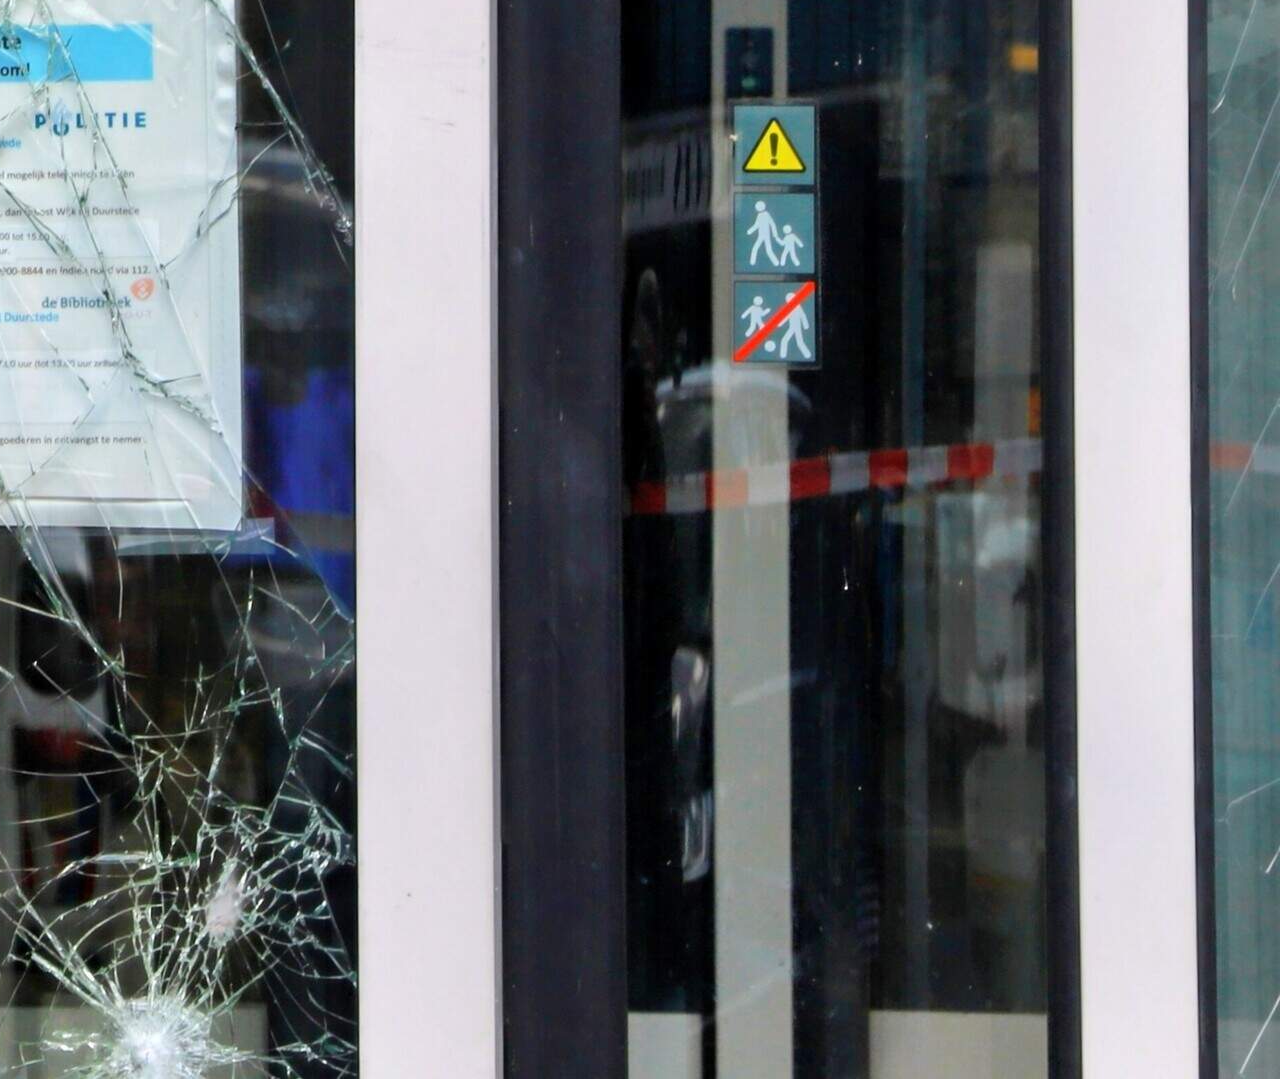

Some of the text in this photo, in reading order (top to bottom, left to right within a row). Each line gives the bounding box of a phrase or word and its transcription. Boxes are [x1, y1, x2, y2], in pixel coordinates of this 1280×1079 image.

[35, 111, 146, 136] POLTIE
[7, 170, 45, 180] mogelijk
[42, 296, 132, 309] de Bibliotek
